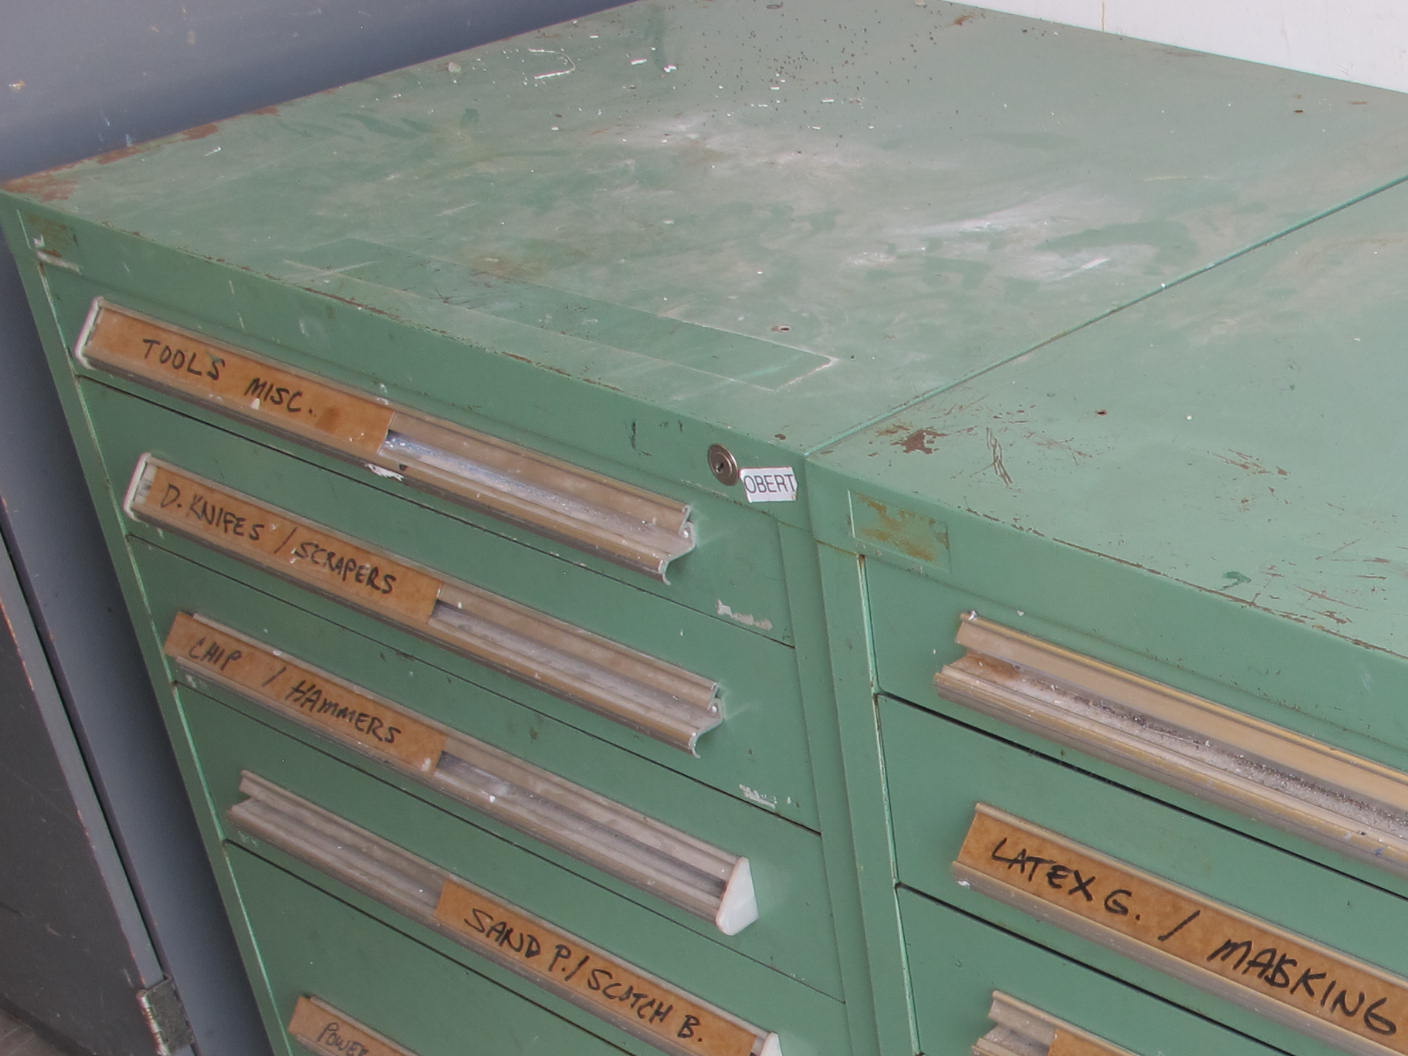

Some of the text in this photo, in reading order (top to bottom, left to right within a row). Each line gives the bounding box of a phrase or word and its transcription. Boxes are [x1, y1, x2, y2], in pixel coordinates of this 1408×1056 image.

[142, 338, 317, 418] TOOLS MISC.
[744, 474, 796, 494] OBERT
[186, 495, 264, 541] KNIFES
[294, 541, 397, 595] SCRAPERS
[188, 637, 242, 671] CHIP
[285, 679, 401, 744] HAMMERS
[464, 908, 542, 959] SAND
[991, 837, 1097, 902] LATEX
[1104, 888, 1141, 921] G.
[1206, 938, 1397, 1036] MASKING
